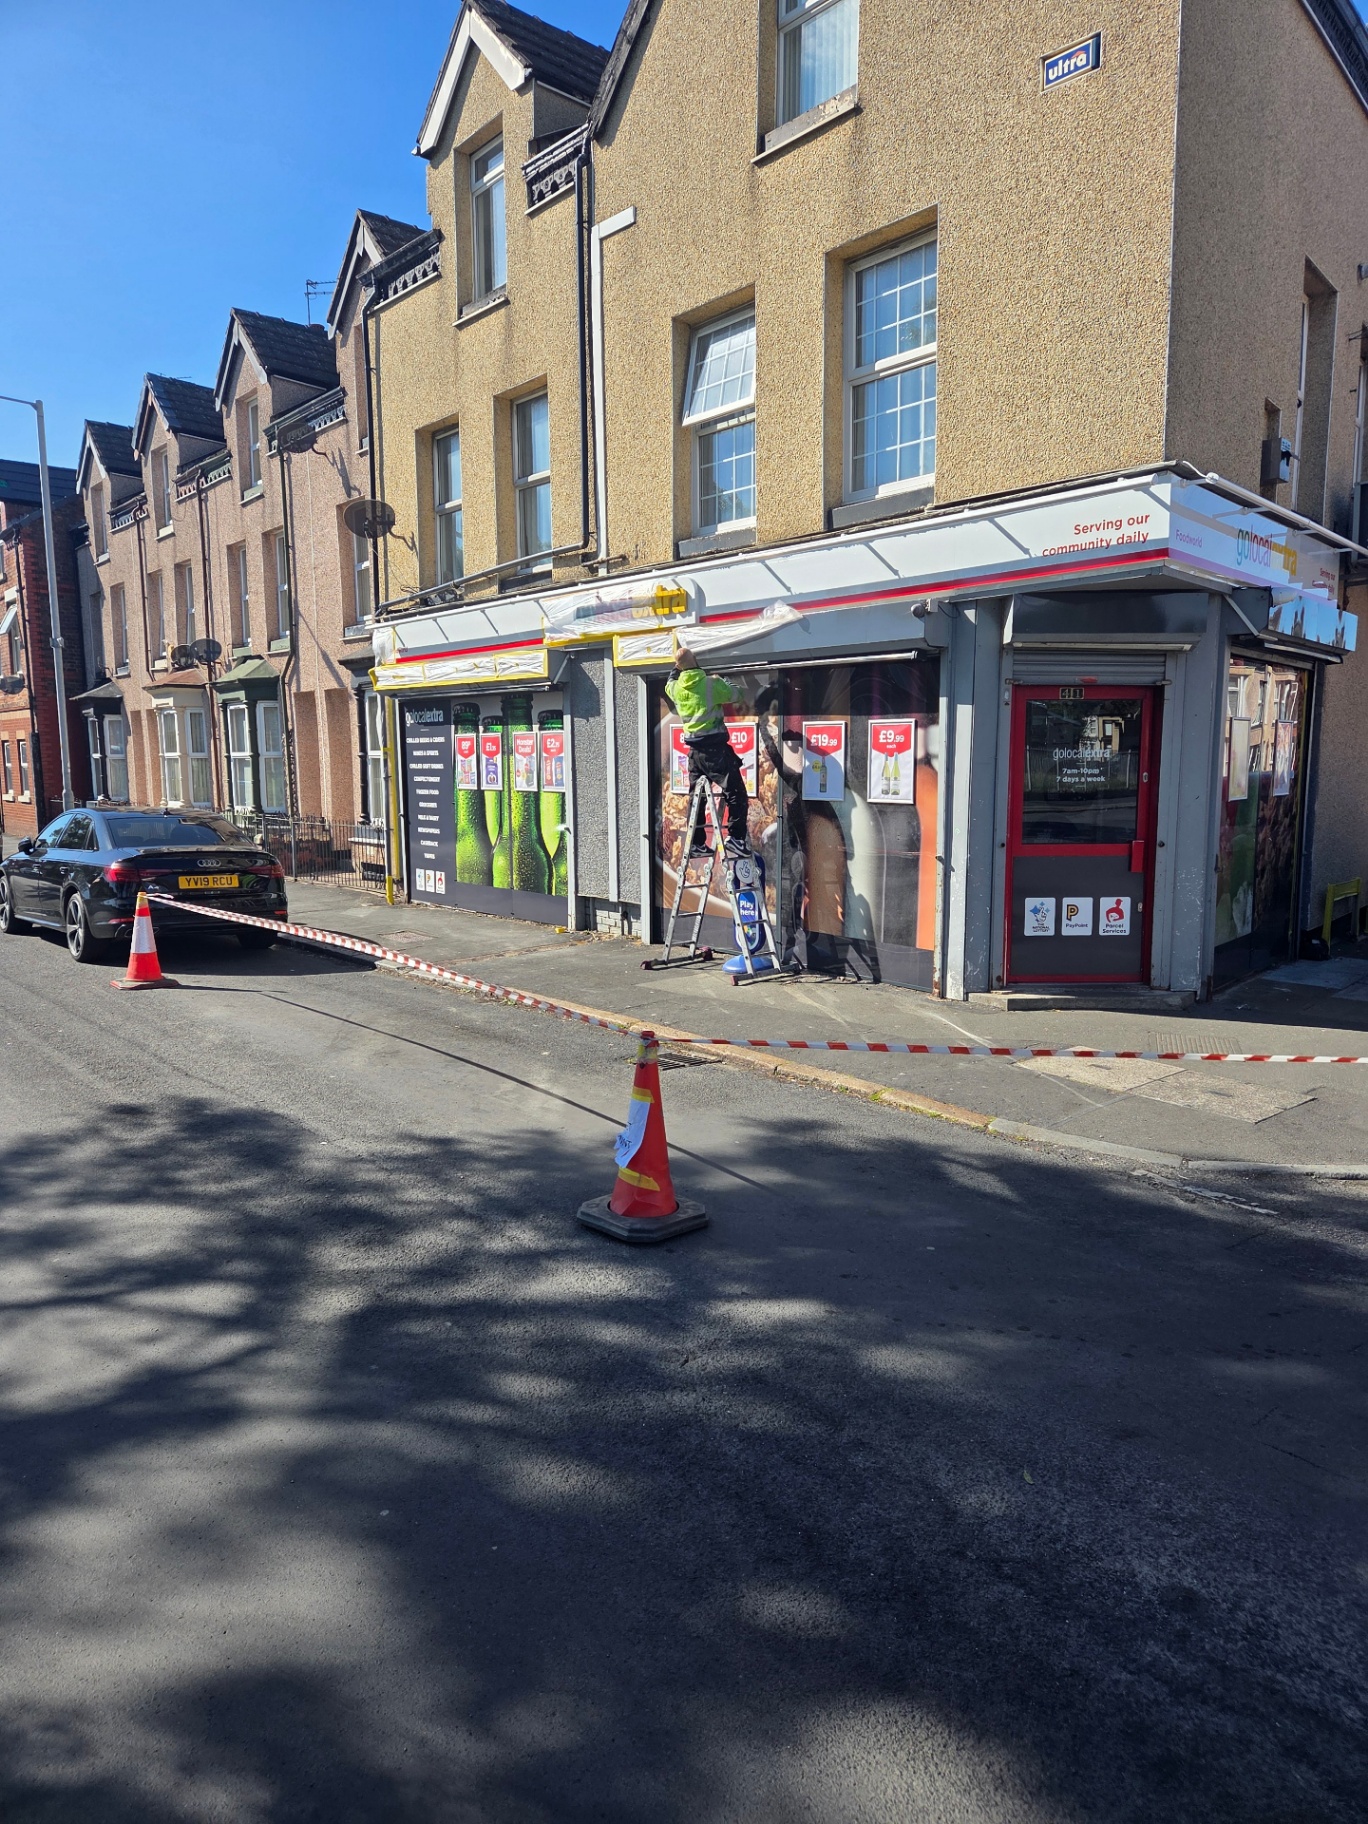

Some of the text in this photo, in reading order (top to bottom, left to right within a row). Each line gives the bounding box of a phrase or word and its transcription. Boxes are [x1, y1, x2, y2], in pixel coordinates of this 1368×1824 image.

[1048, 53, 1087, 80] ultra
[1074, 514, 1150, 535] Serving our
[1042, 531, 1149, 557] community daily
[1175, 529, 1203, 548] Foodworld
[731, 732, 748, 743] £10
[810, 734, 838, 746] £19.99
[879, 730, 905, 742] £9.99
[1052, 747, 1111, 760] golocalextra
[185, 876, 233, 887] YV19 RCU
[740, 900, 754, 910] Play
